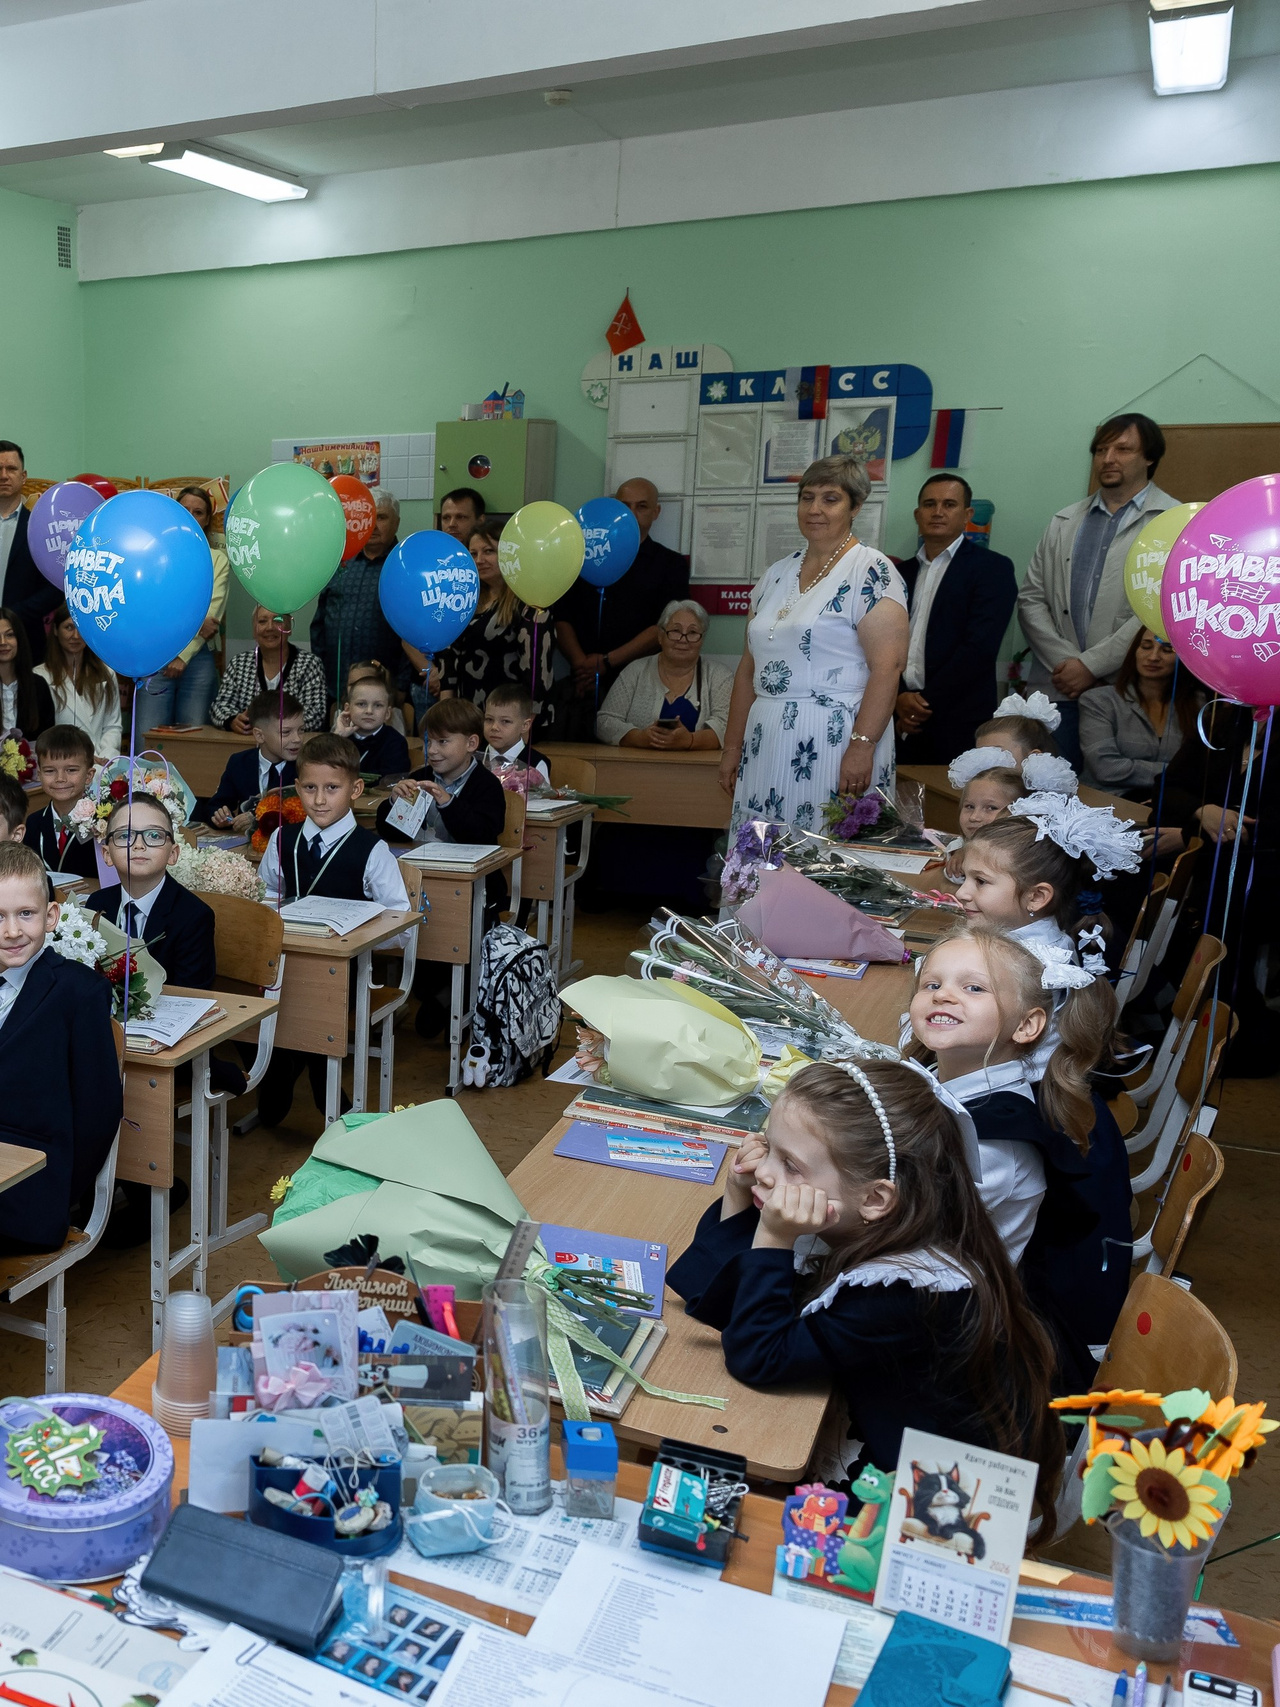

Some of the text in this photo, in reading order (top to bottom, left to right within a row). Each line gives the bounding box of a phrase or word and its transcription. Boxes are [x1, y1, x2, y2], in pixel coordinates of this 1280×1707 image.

[618, 350, 699, 372] НАШ
[739, 370, 891, 396] КЛСС
[300, 445, 324, 455] Наши
[227, 540, 262, 567] ОЛА
[585, 540, 612, 560] ОЛА
[1179, 552, 1280, 585] ПРИВЕ
[728, 602, 748, 610] УГО
[1170, 586, 1280, 640] ШКОЛ
[324, 1272, 409, 1297] Любимой
[357, 1296, 418, 1317] ельниц
[517, 1427, 537, 1439] 36
